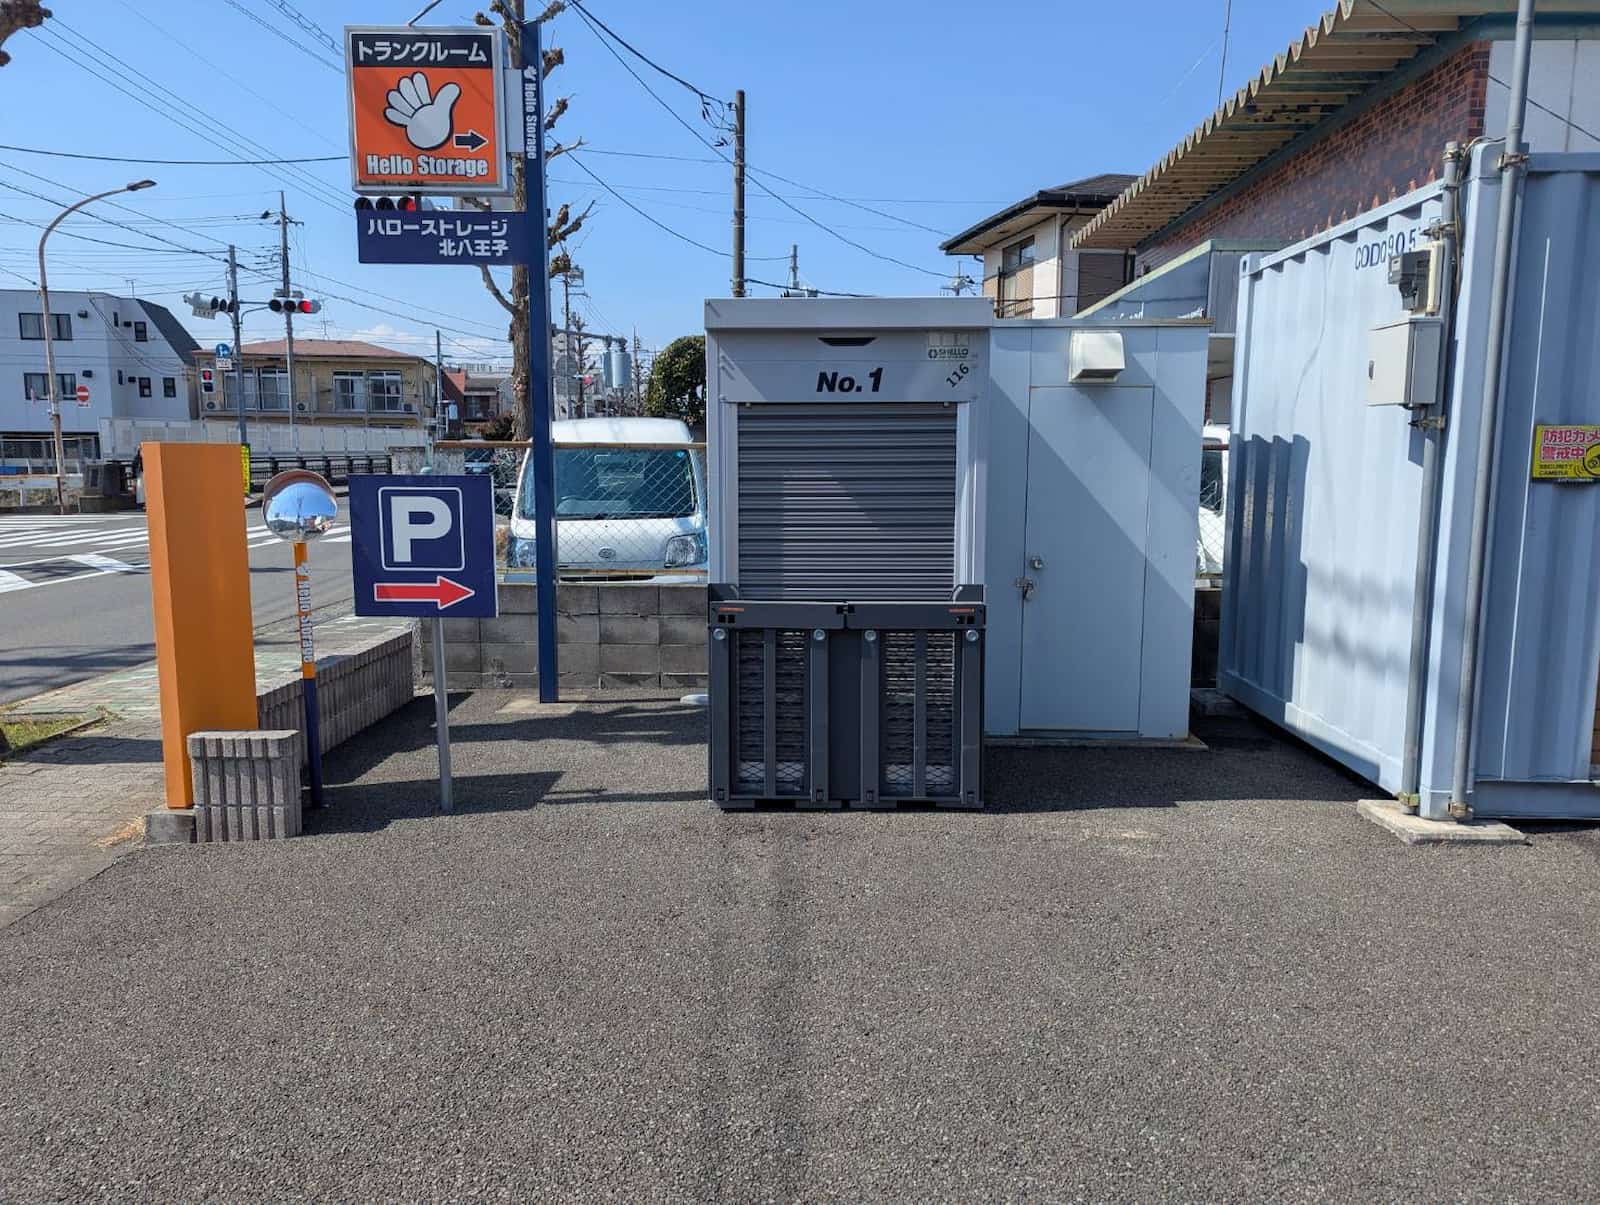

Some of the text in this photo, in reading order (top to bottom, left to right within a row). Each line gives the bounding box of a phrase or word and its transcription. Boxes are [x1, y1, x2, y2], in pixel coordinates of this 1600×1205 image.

[358, 41, 487, 62] トランクルーム
[525, 83, 538, 160] Hello Storage
[366, 154, 488, 178] Hello Storage
[367, 218, 508, 237] ハローストレージ
[438, 239, 509, 257] 北八王子
[945, 362, 969, 388] 116
[390, 495, 453, 563] P
[299, 581, 311, 613] Hello
